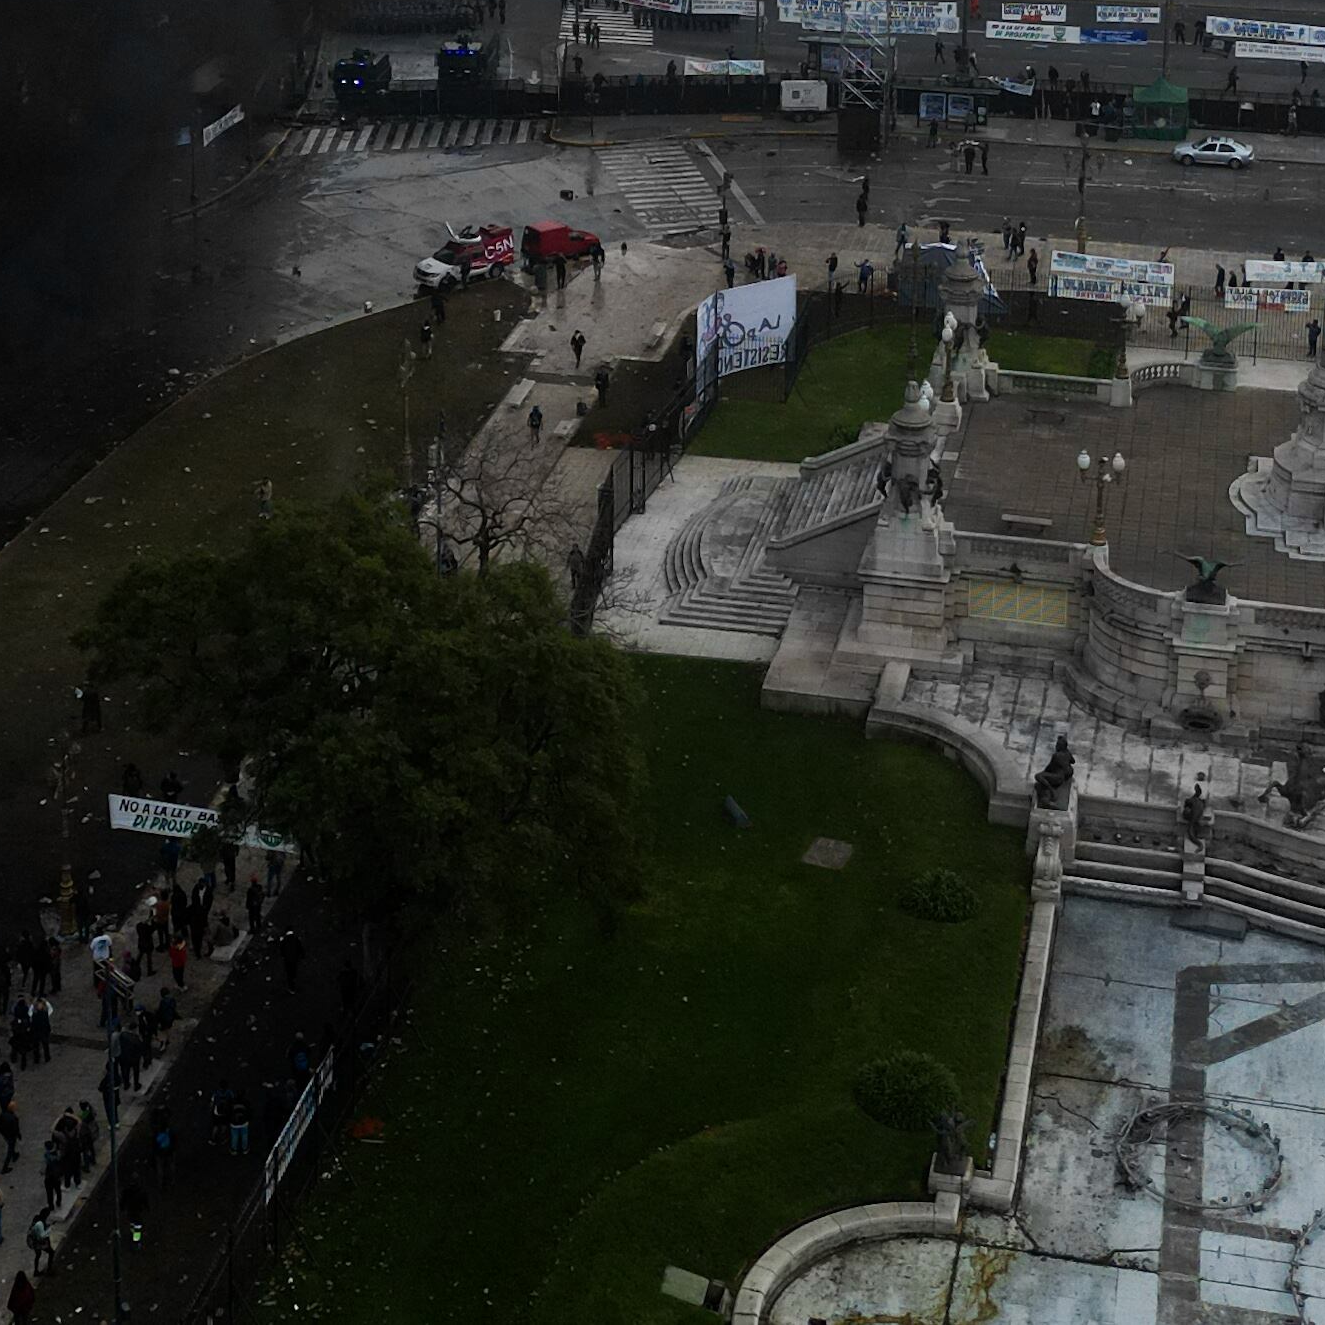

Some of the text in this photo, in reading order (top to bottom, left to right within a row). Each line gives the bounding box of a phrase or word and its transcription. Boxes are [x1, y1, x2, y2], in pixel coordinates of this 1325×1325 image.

[484, 235, 514, 260] C5N
[119, 799, 221, 825] NO A LA LEY BAS
[132, 815, 147, 829] DI
